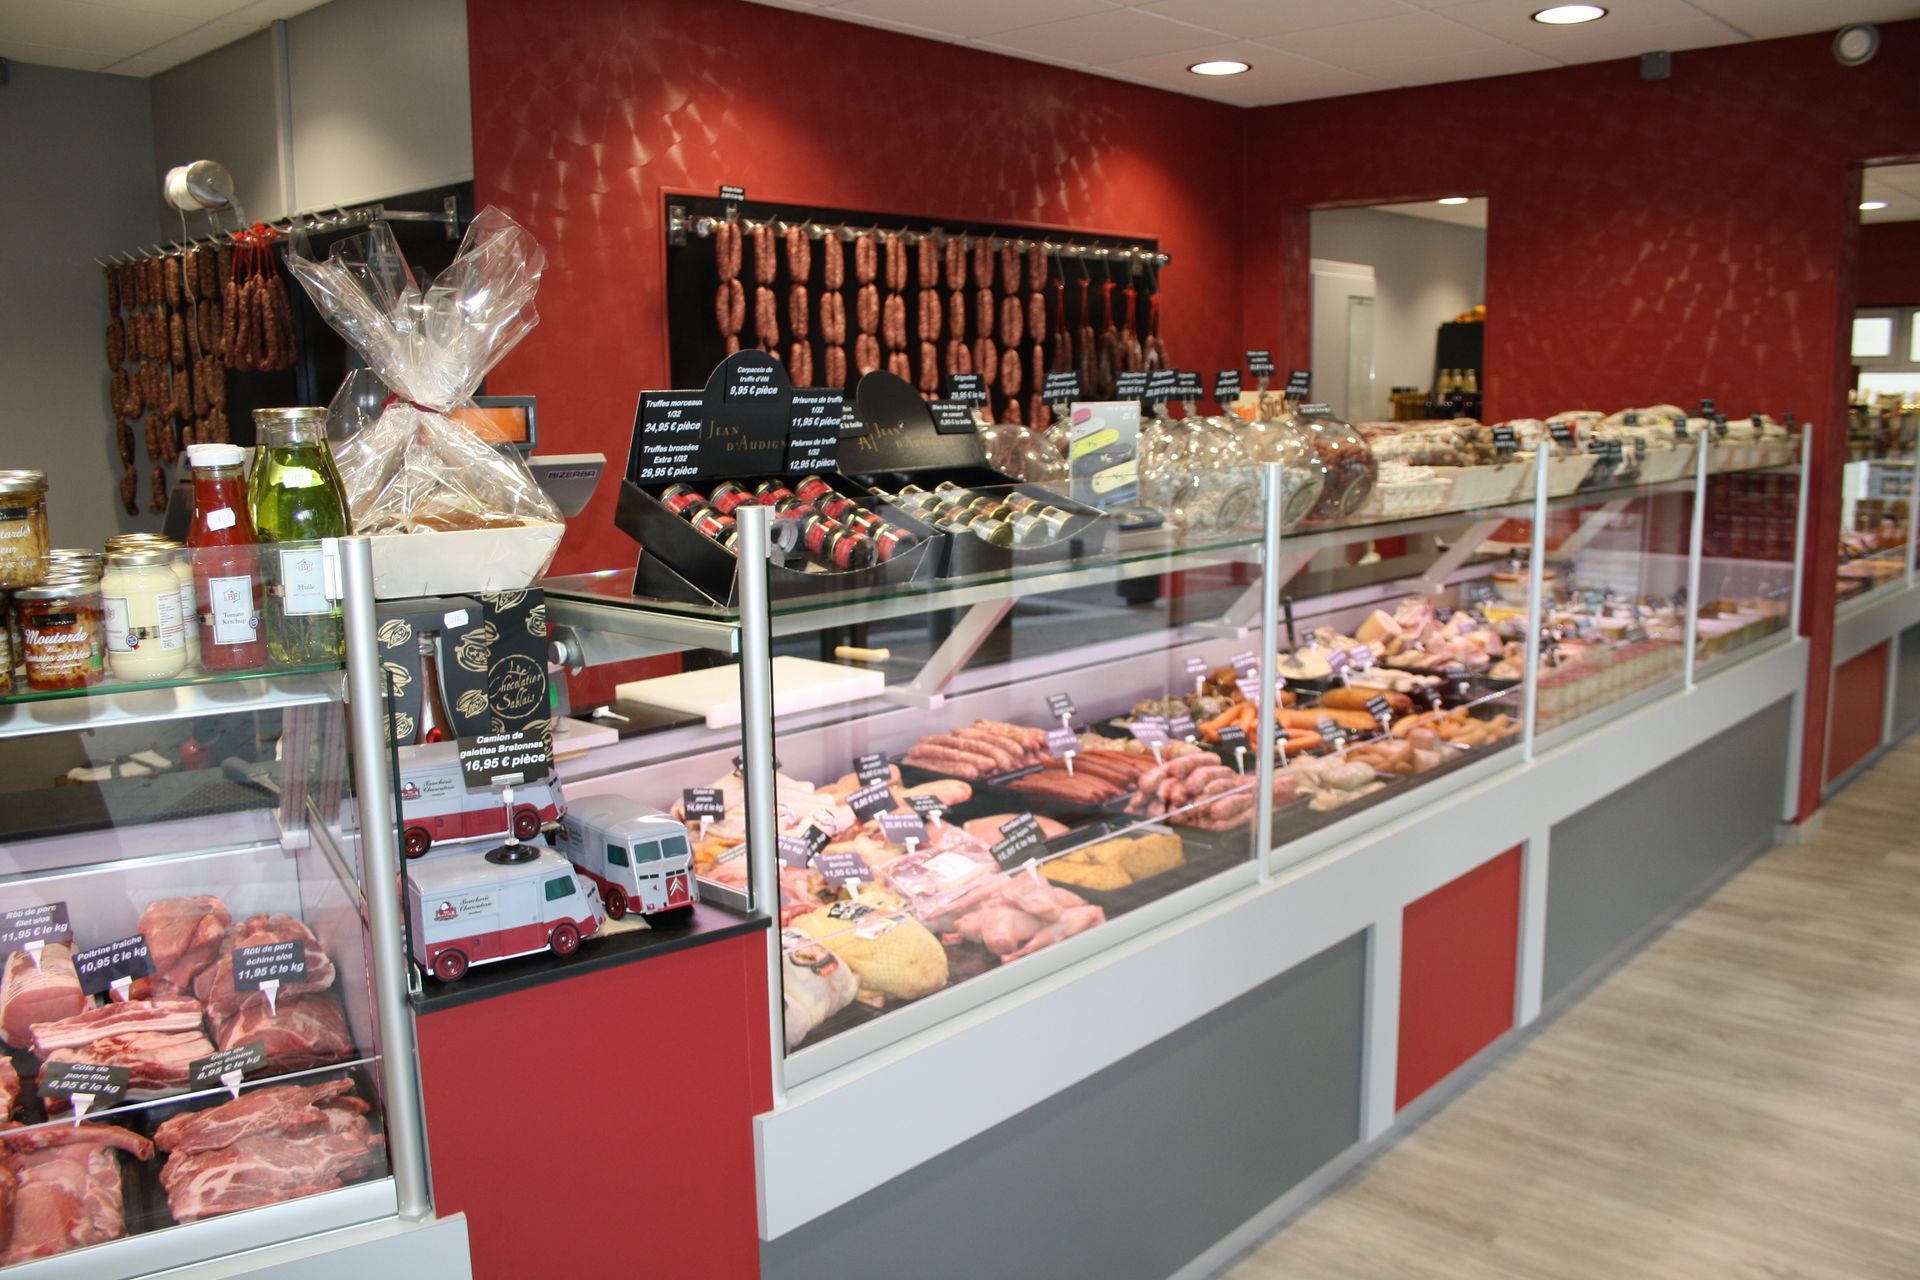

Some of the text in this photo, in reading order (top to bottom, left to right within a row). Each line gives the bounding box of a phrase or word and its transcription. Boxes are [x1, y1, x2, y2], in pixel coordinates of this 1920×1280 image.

[729, 385, 778, 396] 9,95 € pièce
[646, 399, 703, 408] Truffes morceaux
[644, 421, 701, 433] 24,95 € pièce
[792, 417, 813, 427] 11,95
[814, 417, 820, 425] €
[820, 416, 841, 427] pièce
[813, 438, 821, 446] de
[644, 444, 700, 454] Truffes brossées
[653, 456, 672, 464] Extra
[790, 458, 836, 470] 12,95 € pièce
[548, 470, 596, 479] BIZERBA
[641, 465, 698, 479] 29,95 € pièce
[0, 526, 30, 538] tarde
[25, 626, 88, 645] Moutarde
[476, 731, 524, 744] Camion de
[460, 741, 544, 759] galettes Bretonnes
[465, 753, 546, 772] 16,95 € pièce
[879, 789, 889, 799] kg
[715, 803, 724, 813] kg
[859, 867, 869, 876] kg
[6, 904, 56, 920] Rôti de porc
[15, 918, 32, 927] filet
[2, 922, 68, 942] 11,95 € le kg
[77, 946, 111, 961] Poitrine
[243, 942, 294, 956] Rôti de porc
[80, 946, 147, 974] 10,95 € le kg
[246, 957, 275, 966] échine
[238, 961, 304, 980] 11,95 € le kg
[71, 1063, 95, 1072] Côte
[202, 1059, 223, 1071] porc
[224, 1062, 232, 1071] €
[234, 1059, 244, 1068] le
[246, 1055, 261, 1065] kg
[64, 1072, 111, 1081] porc filet
[79, 1082, 90, 1090] €
[89, 1083, 102, 1091] le
[103, 1084, 121, 1094] kg
